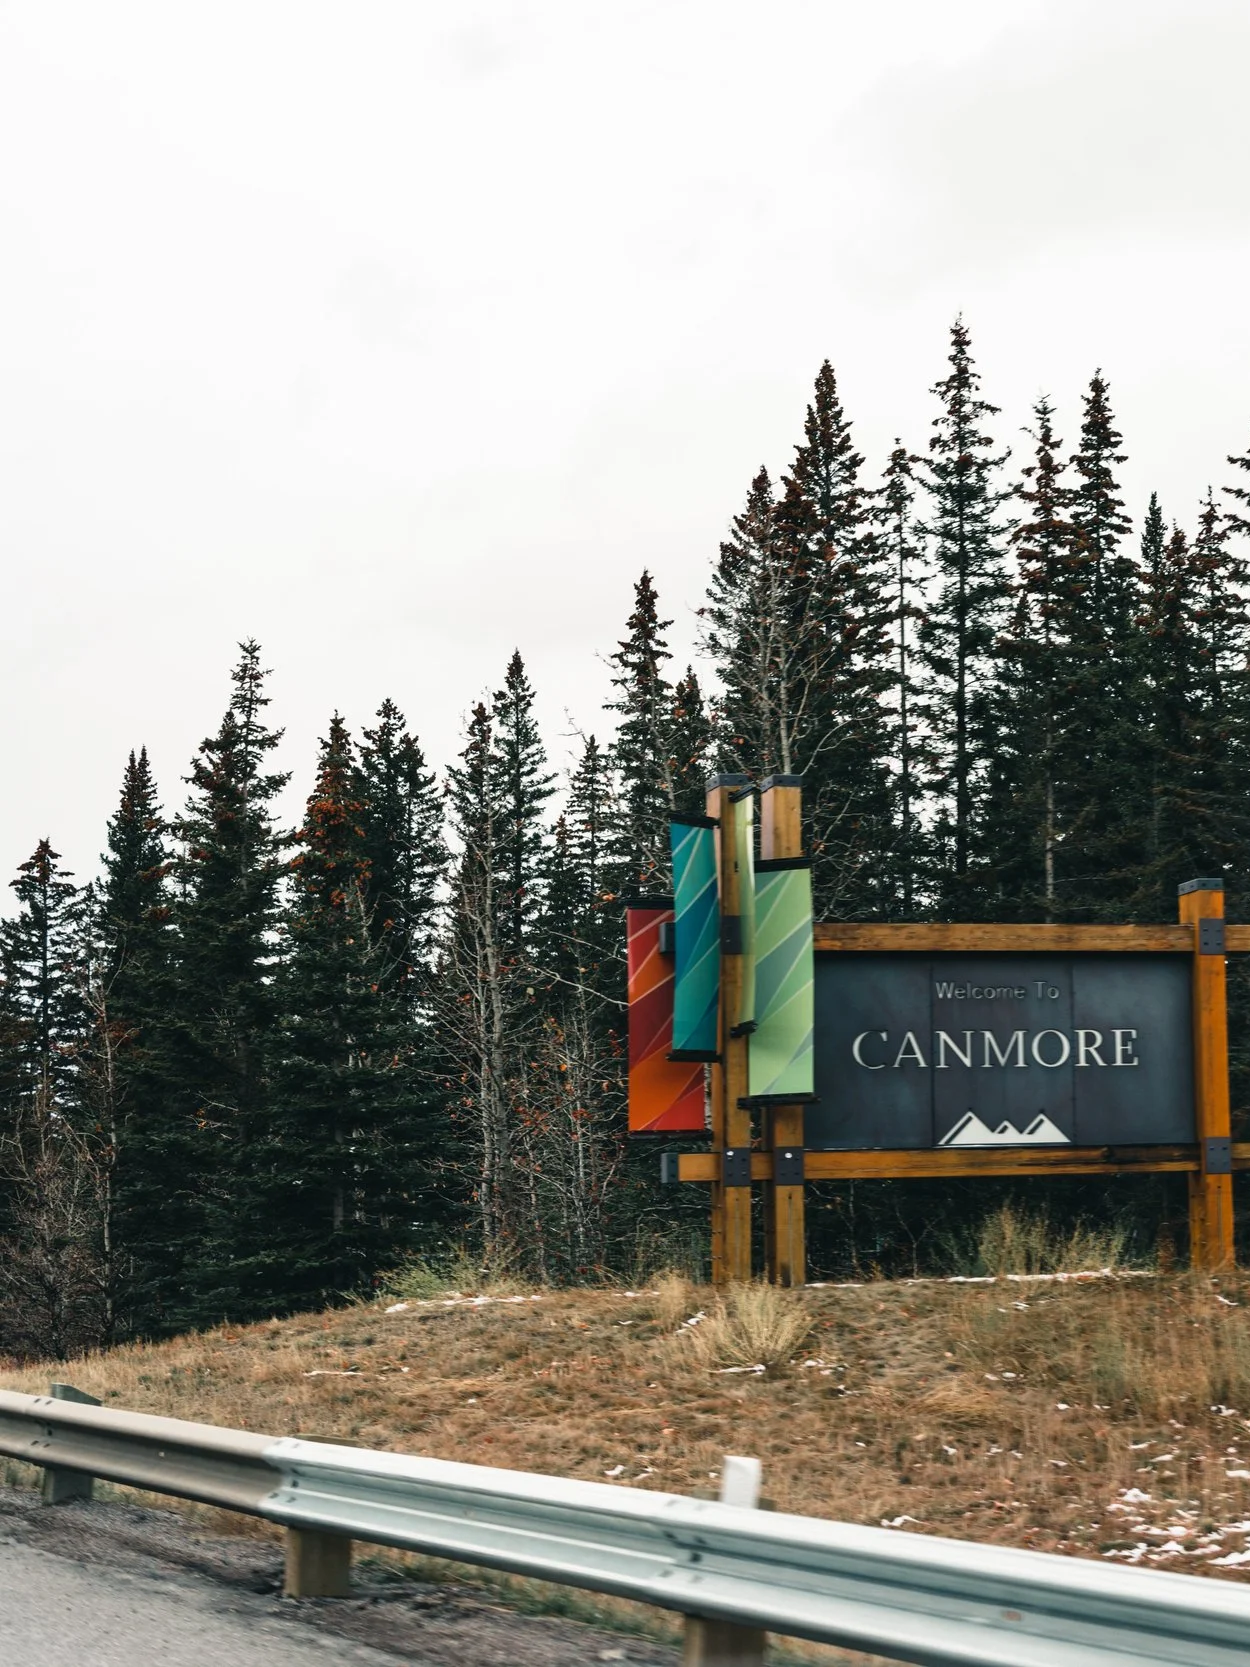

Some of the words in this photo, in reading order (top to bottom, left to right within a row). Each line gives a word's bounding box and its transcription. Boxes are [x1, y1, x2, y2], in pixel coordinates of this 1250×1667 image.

[935, 981, 1026, 999] Welcome
[1033, 981, 1060, 999] To
[851, 1028, 1139, 1070] CANMORE
